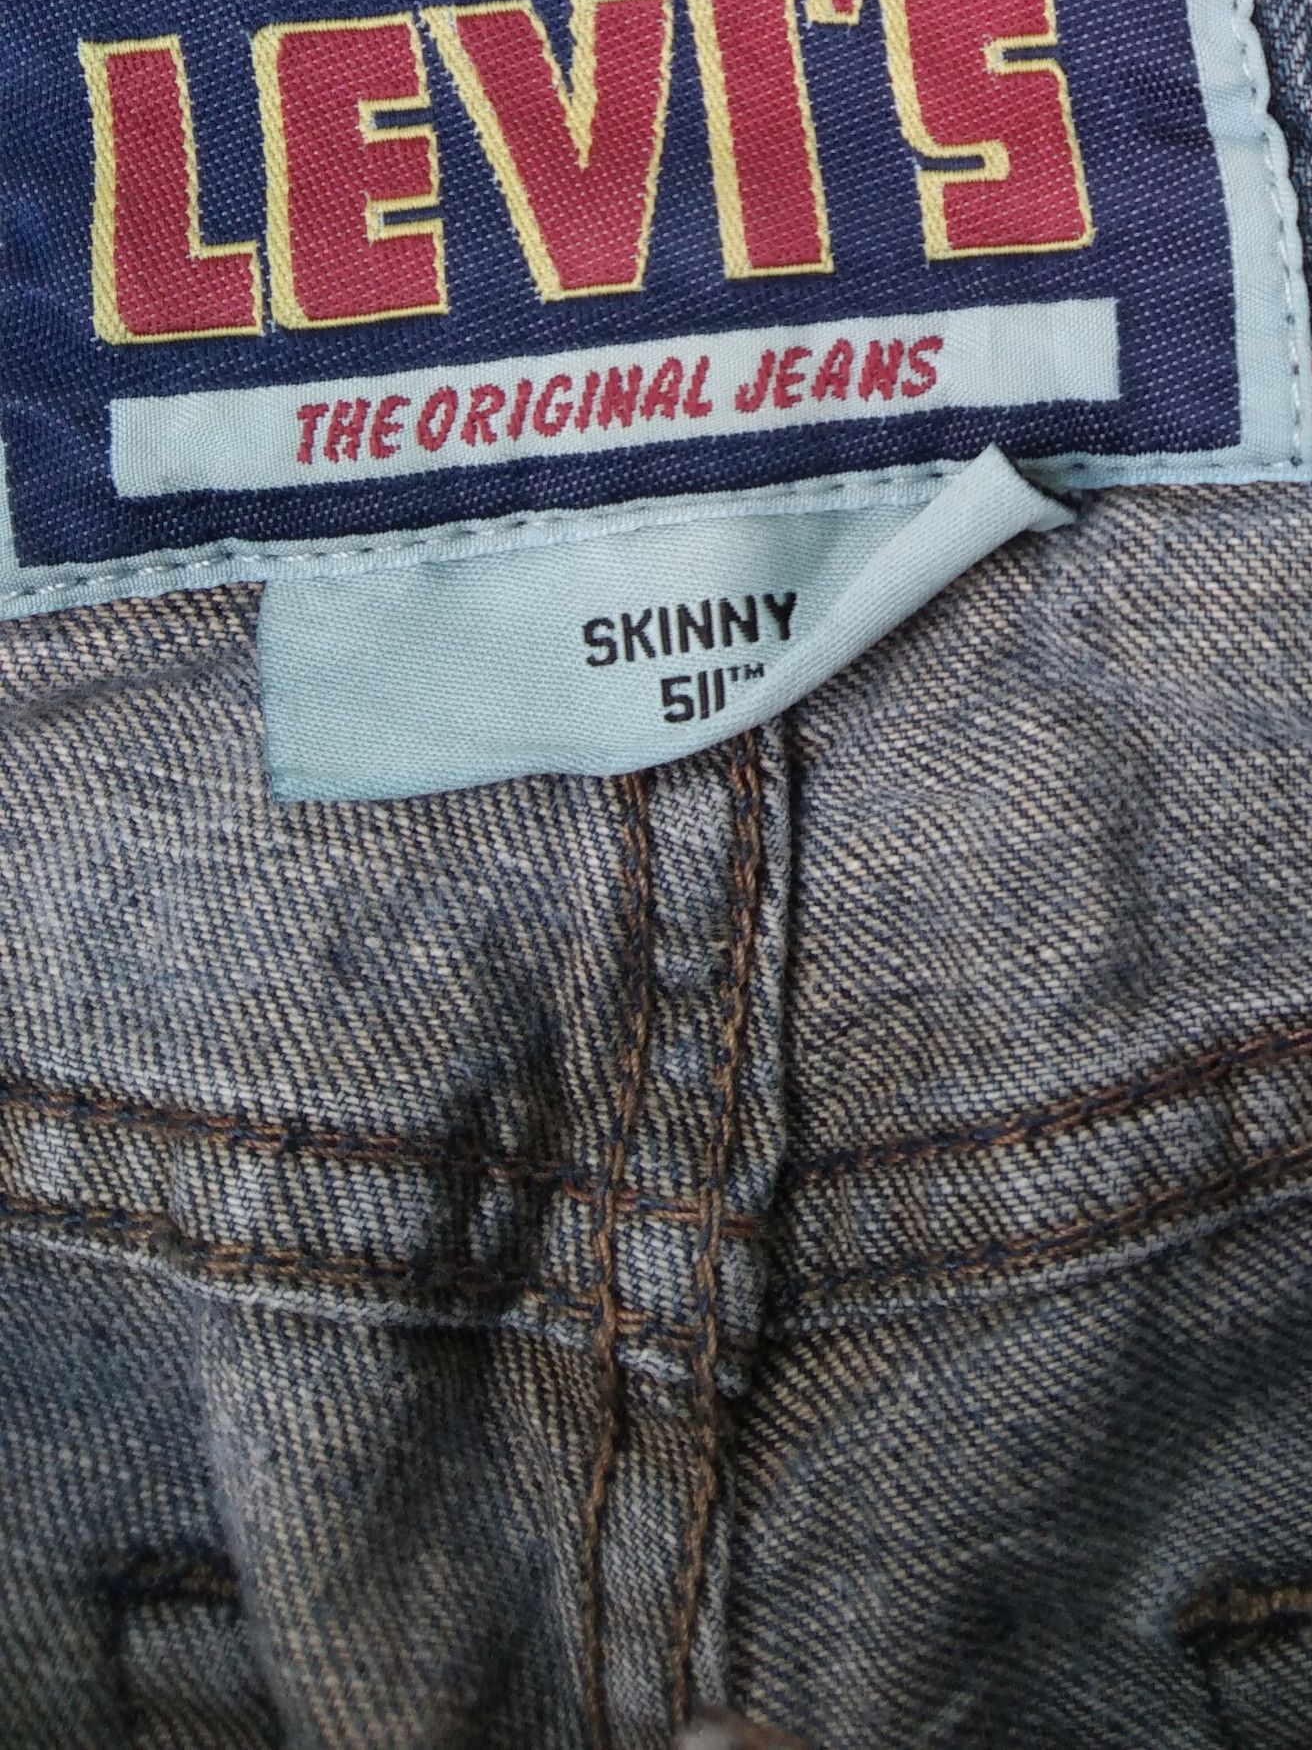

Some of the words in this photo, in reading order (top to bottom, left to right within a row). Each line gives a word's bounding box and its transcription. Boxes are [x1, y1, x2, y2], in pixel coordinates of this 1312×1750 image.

[297, 396, 410, 465] THE
[416, 354, 713, 453] ORIGINAL
[735, 335, 944, 414] JEANS
[582, 592, 797, 667] SKINNY
